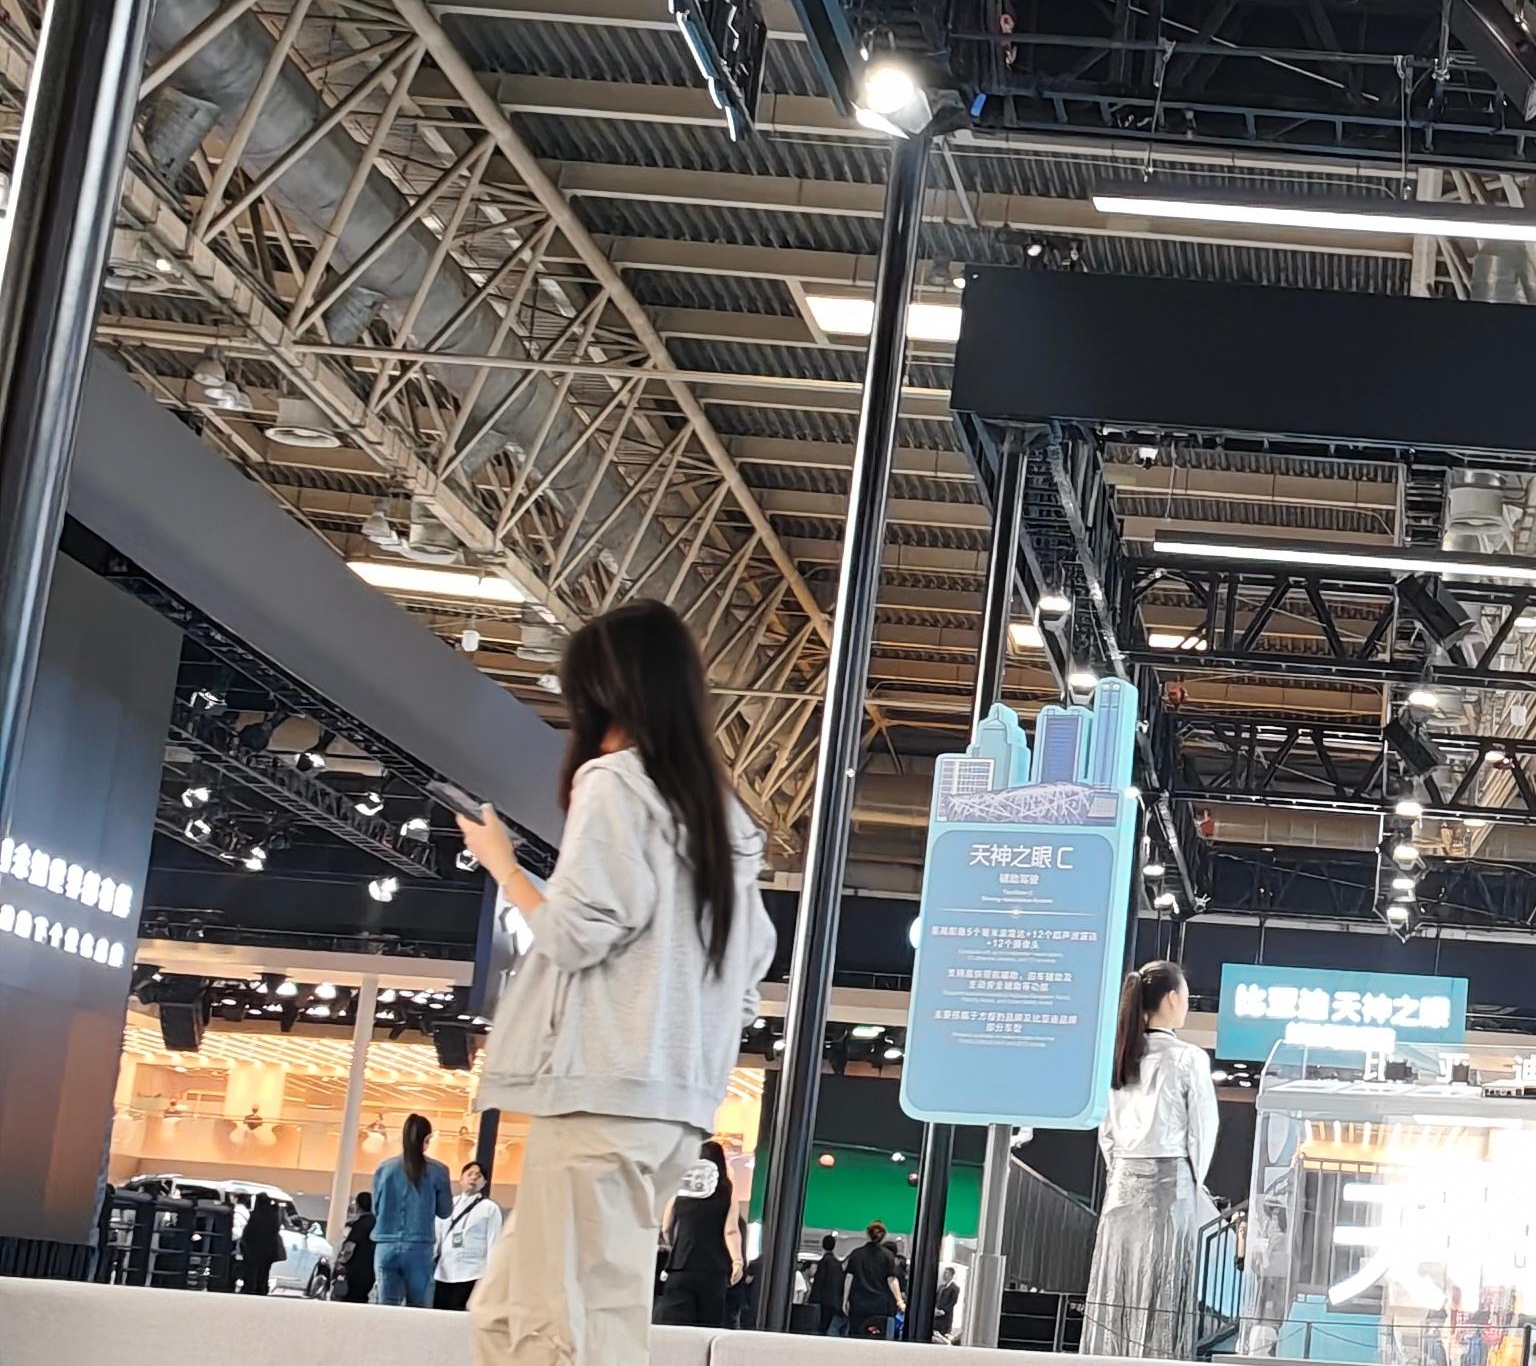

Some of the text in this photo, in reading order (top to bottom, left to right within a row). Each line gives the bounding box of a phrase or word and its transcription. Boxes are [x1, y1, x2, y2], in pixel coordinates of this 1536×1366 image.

[968, 843, 1074, 870] 天神之眼 C
